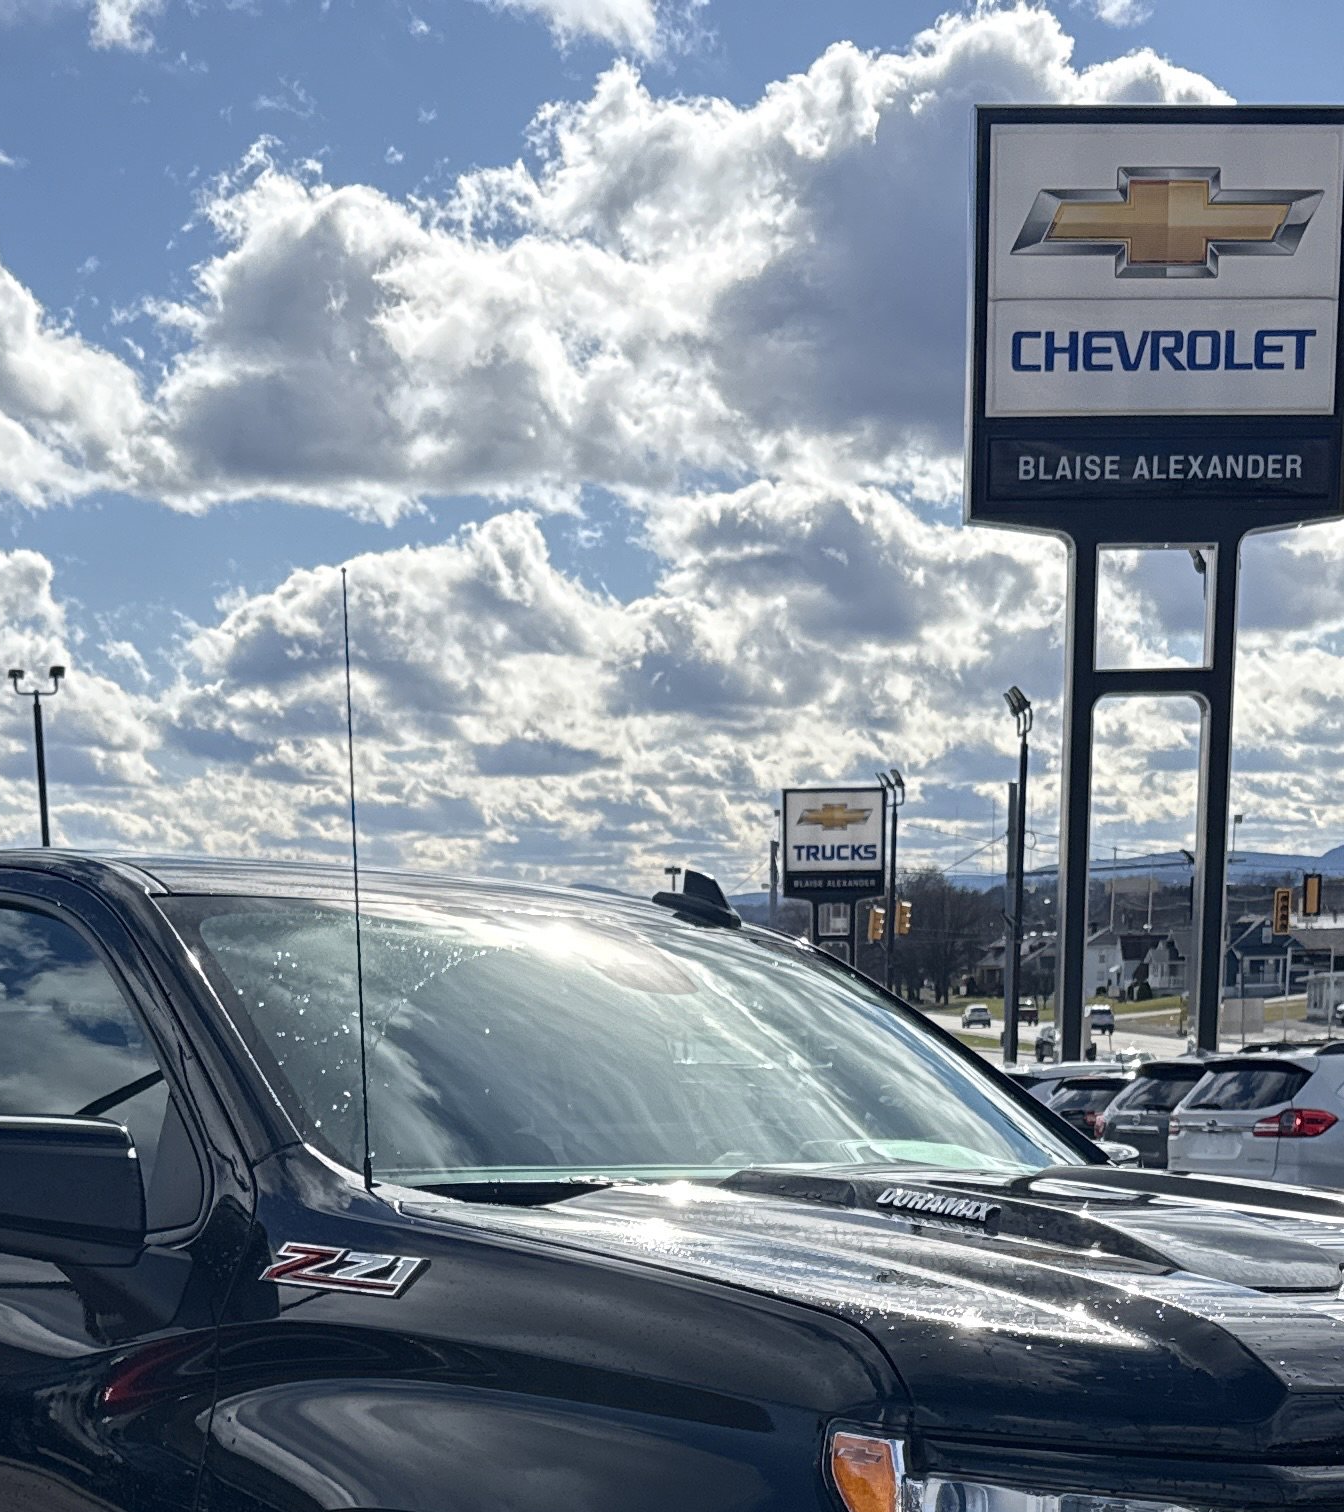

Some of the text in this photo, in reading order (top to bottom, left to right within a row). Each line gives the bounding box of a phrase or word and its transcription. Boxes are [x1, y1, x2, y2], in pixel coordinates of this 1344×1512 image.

[1011, 330, 1317, 372] CHEVROLET
[1017, 454, 1303, 481] BLAISE ALEXANDER
[792, 844, 876, 861] TRUCKS
[876, 1187, 998, 1222] DURAMAX
[258, 1241, 431, 1298] Z71
